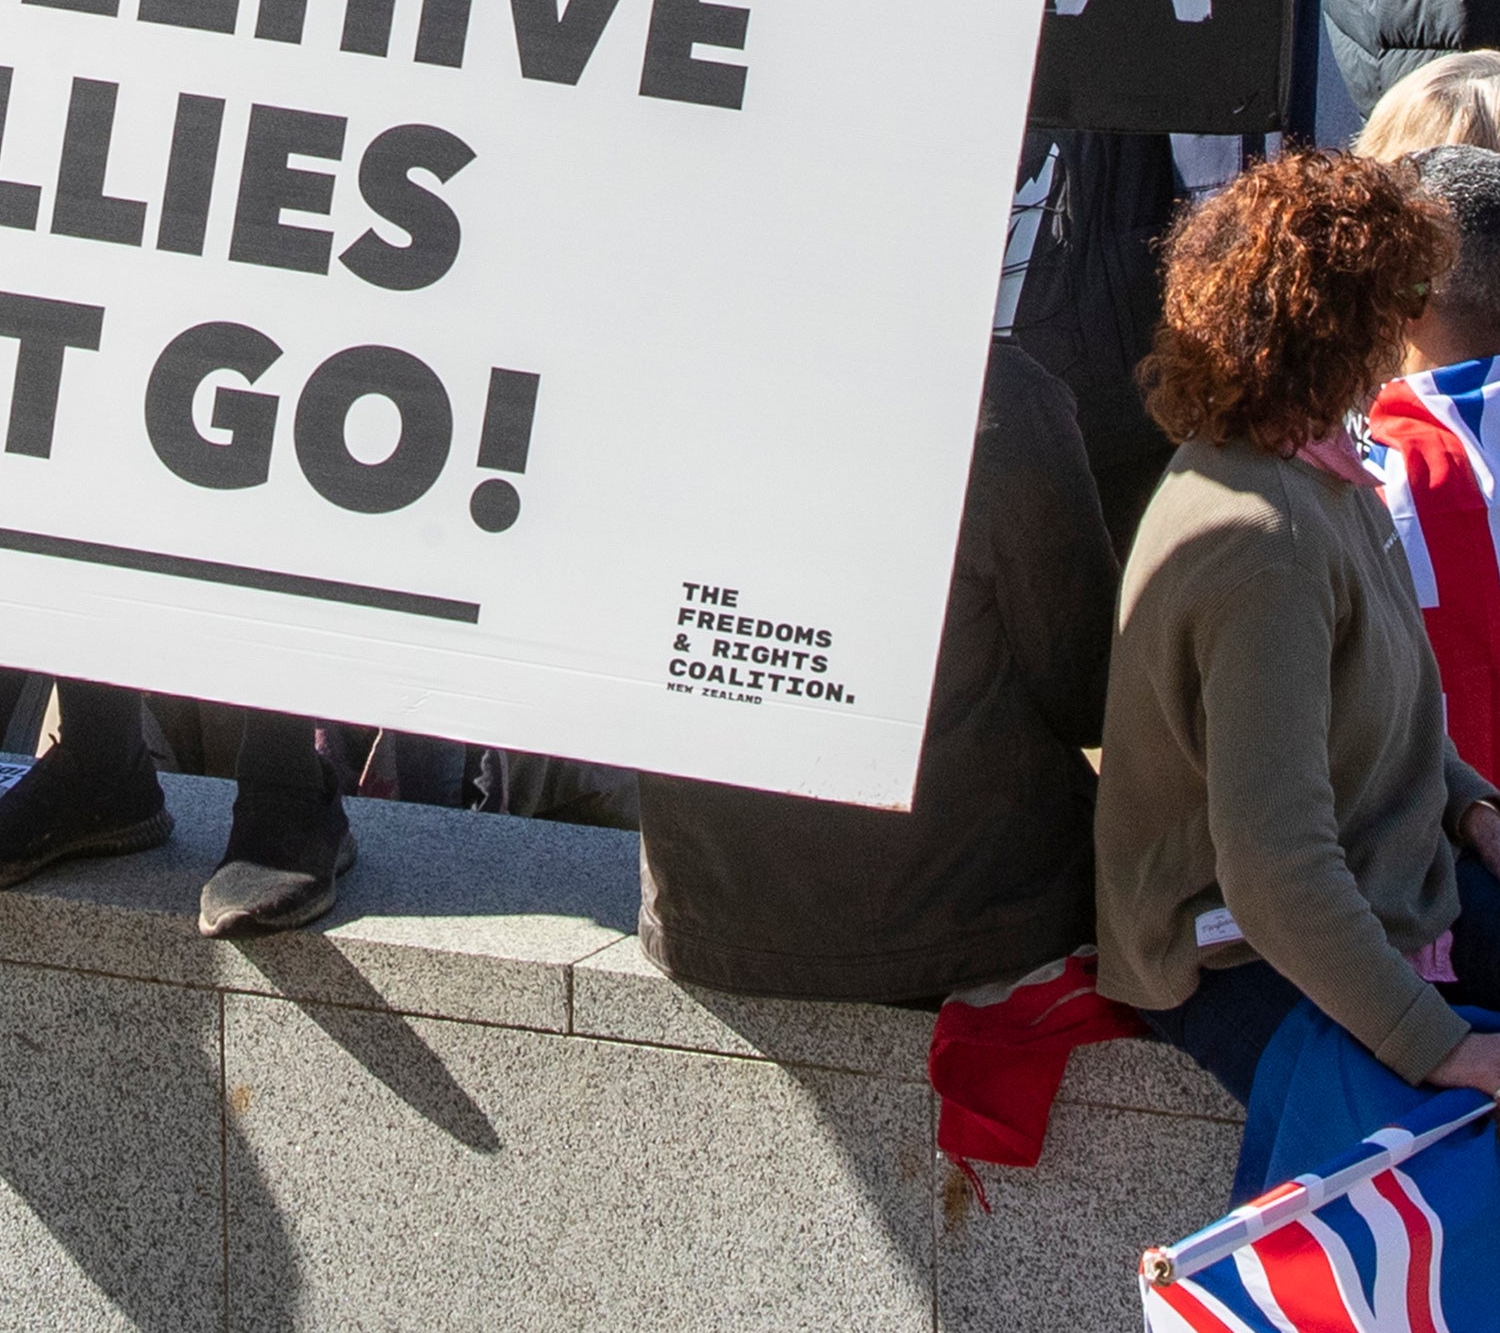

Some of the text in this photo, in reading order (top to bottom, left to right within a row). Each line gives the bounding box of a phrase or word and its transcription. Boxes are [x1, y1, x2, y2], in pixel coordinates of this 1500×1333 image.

[144, 321, 541, 533] GO!
[682, 582, 739, 608] THE
[677, 607, 832, 648] FREEDOMS
[673, 633, 828, 673] & RIGHTS
[667, 682, 763, 706] NEW ZEALAND
[669, 658, 855, 704] COALITION.
